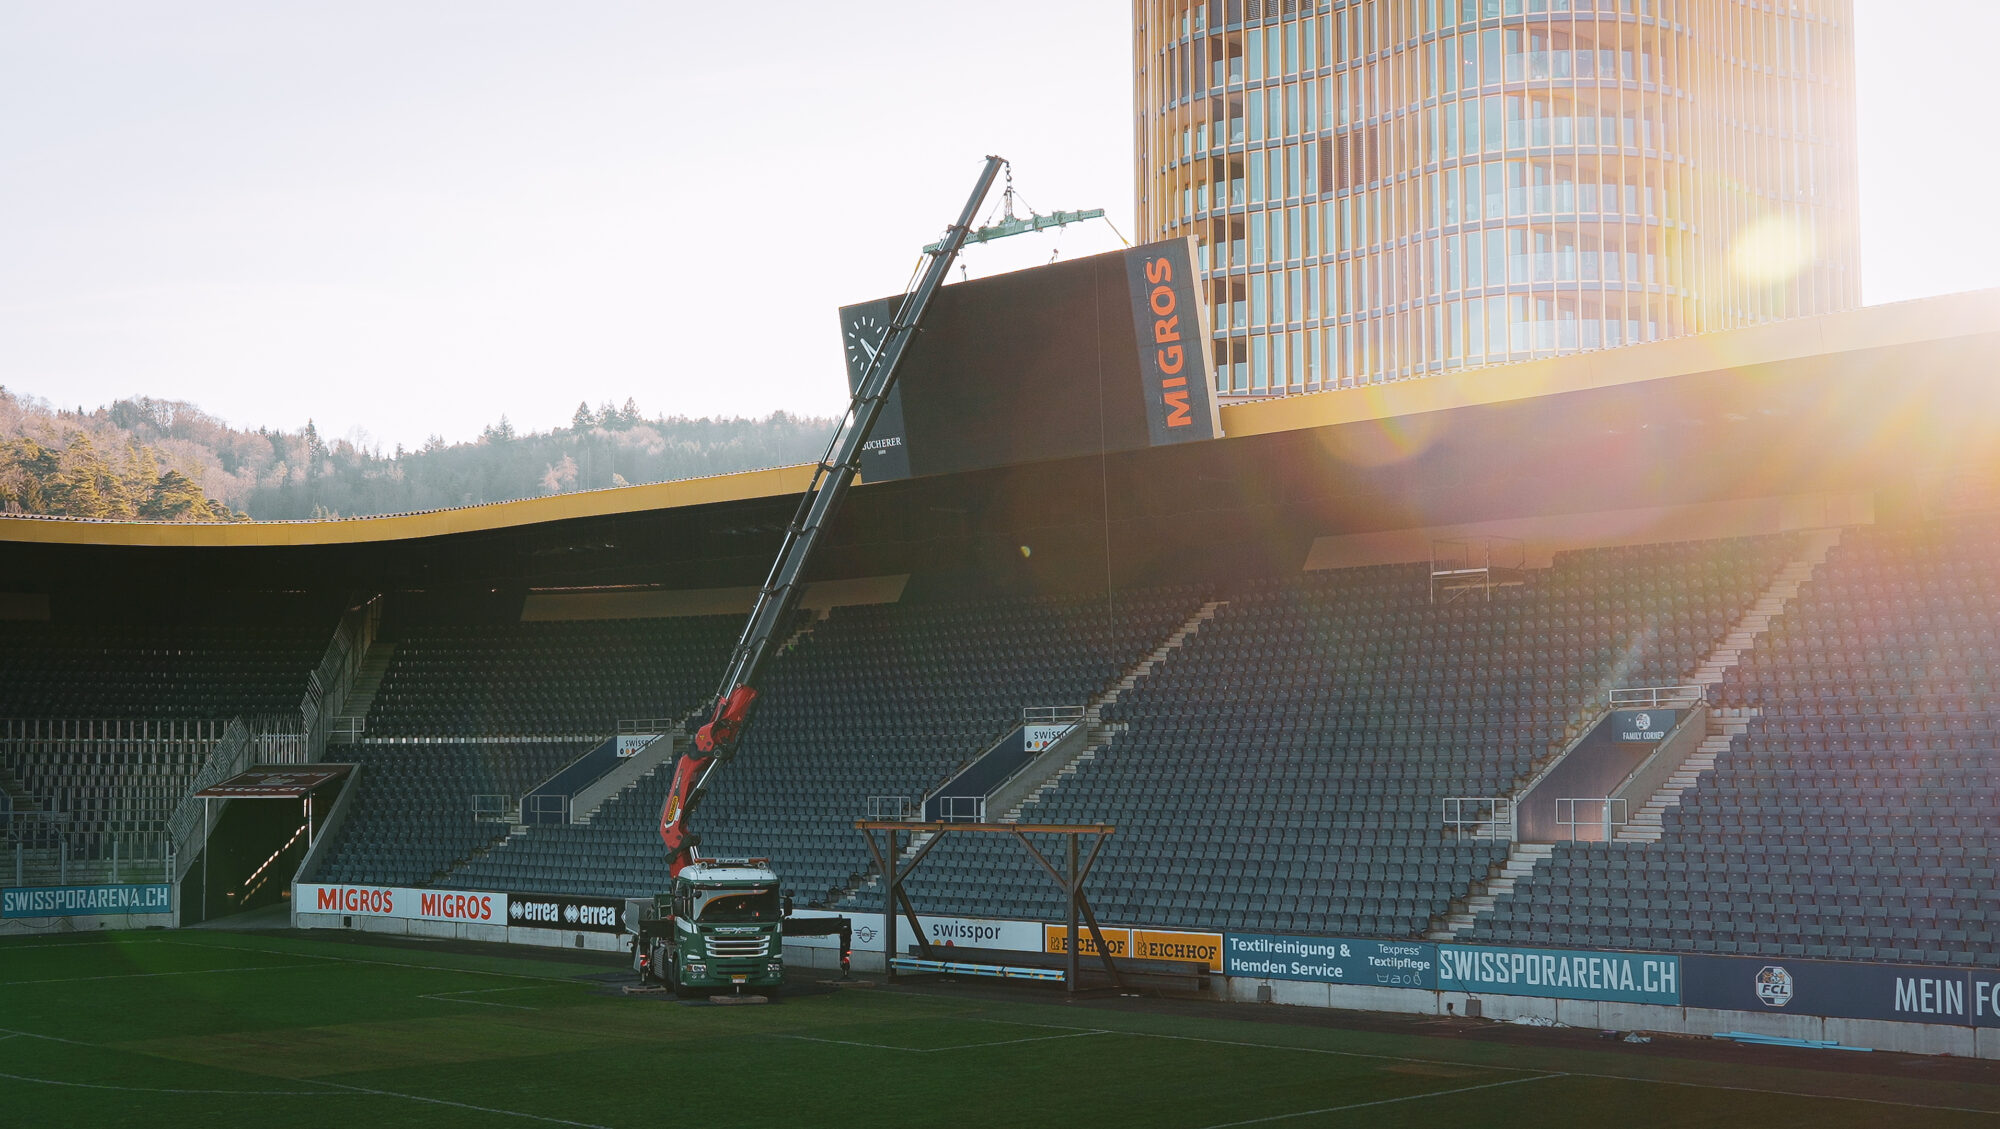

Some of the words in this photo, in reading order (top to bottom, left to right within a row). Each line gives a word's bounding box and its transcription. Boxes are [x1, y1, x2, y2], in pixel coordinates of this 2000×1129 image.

[1147, 258, 1191, 427] MIGROS
[1623, 731, 1642, 740] FAMILY
[4, 887, 168, 912] SWISSPORARENA.CH
[317, 888, 393, 914] MIGROS
[421, 893, 491, 920] MIGROS
[933, 921, 1001, 943] swisspor
[1061, 937, 1125, 954] ECHOF
[1149, 943, 1217, 960] EICHHOF
[1231, 938, 1336, 959] Textilreinigung
[1339, 943, 1351, 957] &
[1231, 958, 1287, 974] Hemden
[1291, 962, 1343, 978] Service
[1368, 956, 1430, 970] Textilpflege
[1440, 950, 1675, 993] SWISSPORARENA.CH
[1762, 984, 1788, 995] FCL
[1895, 977, 1964, 1016] MEIN
